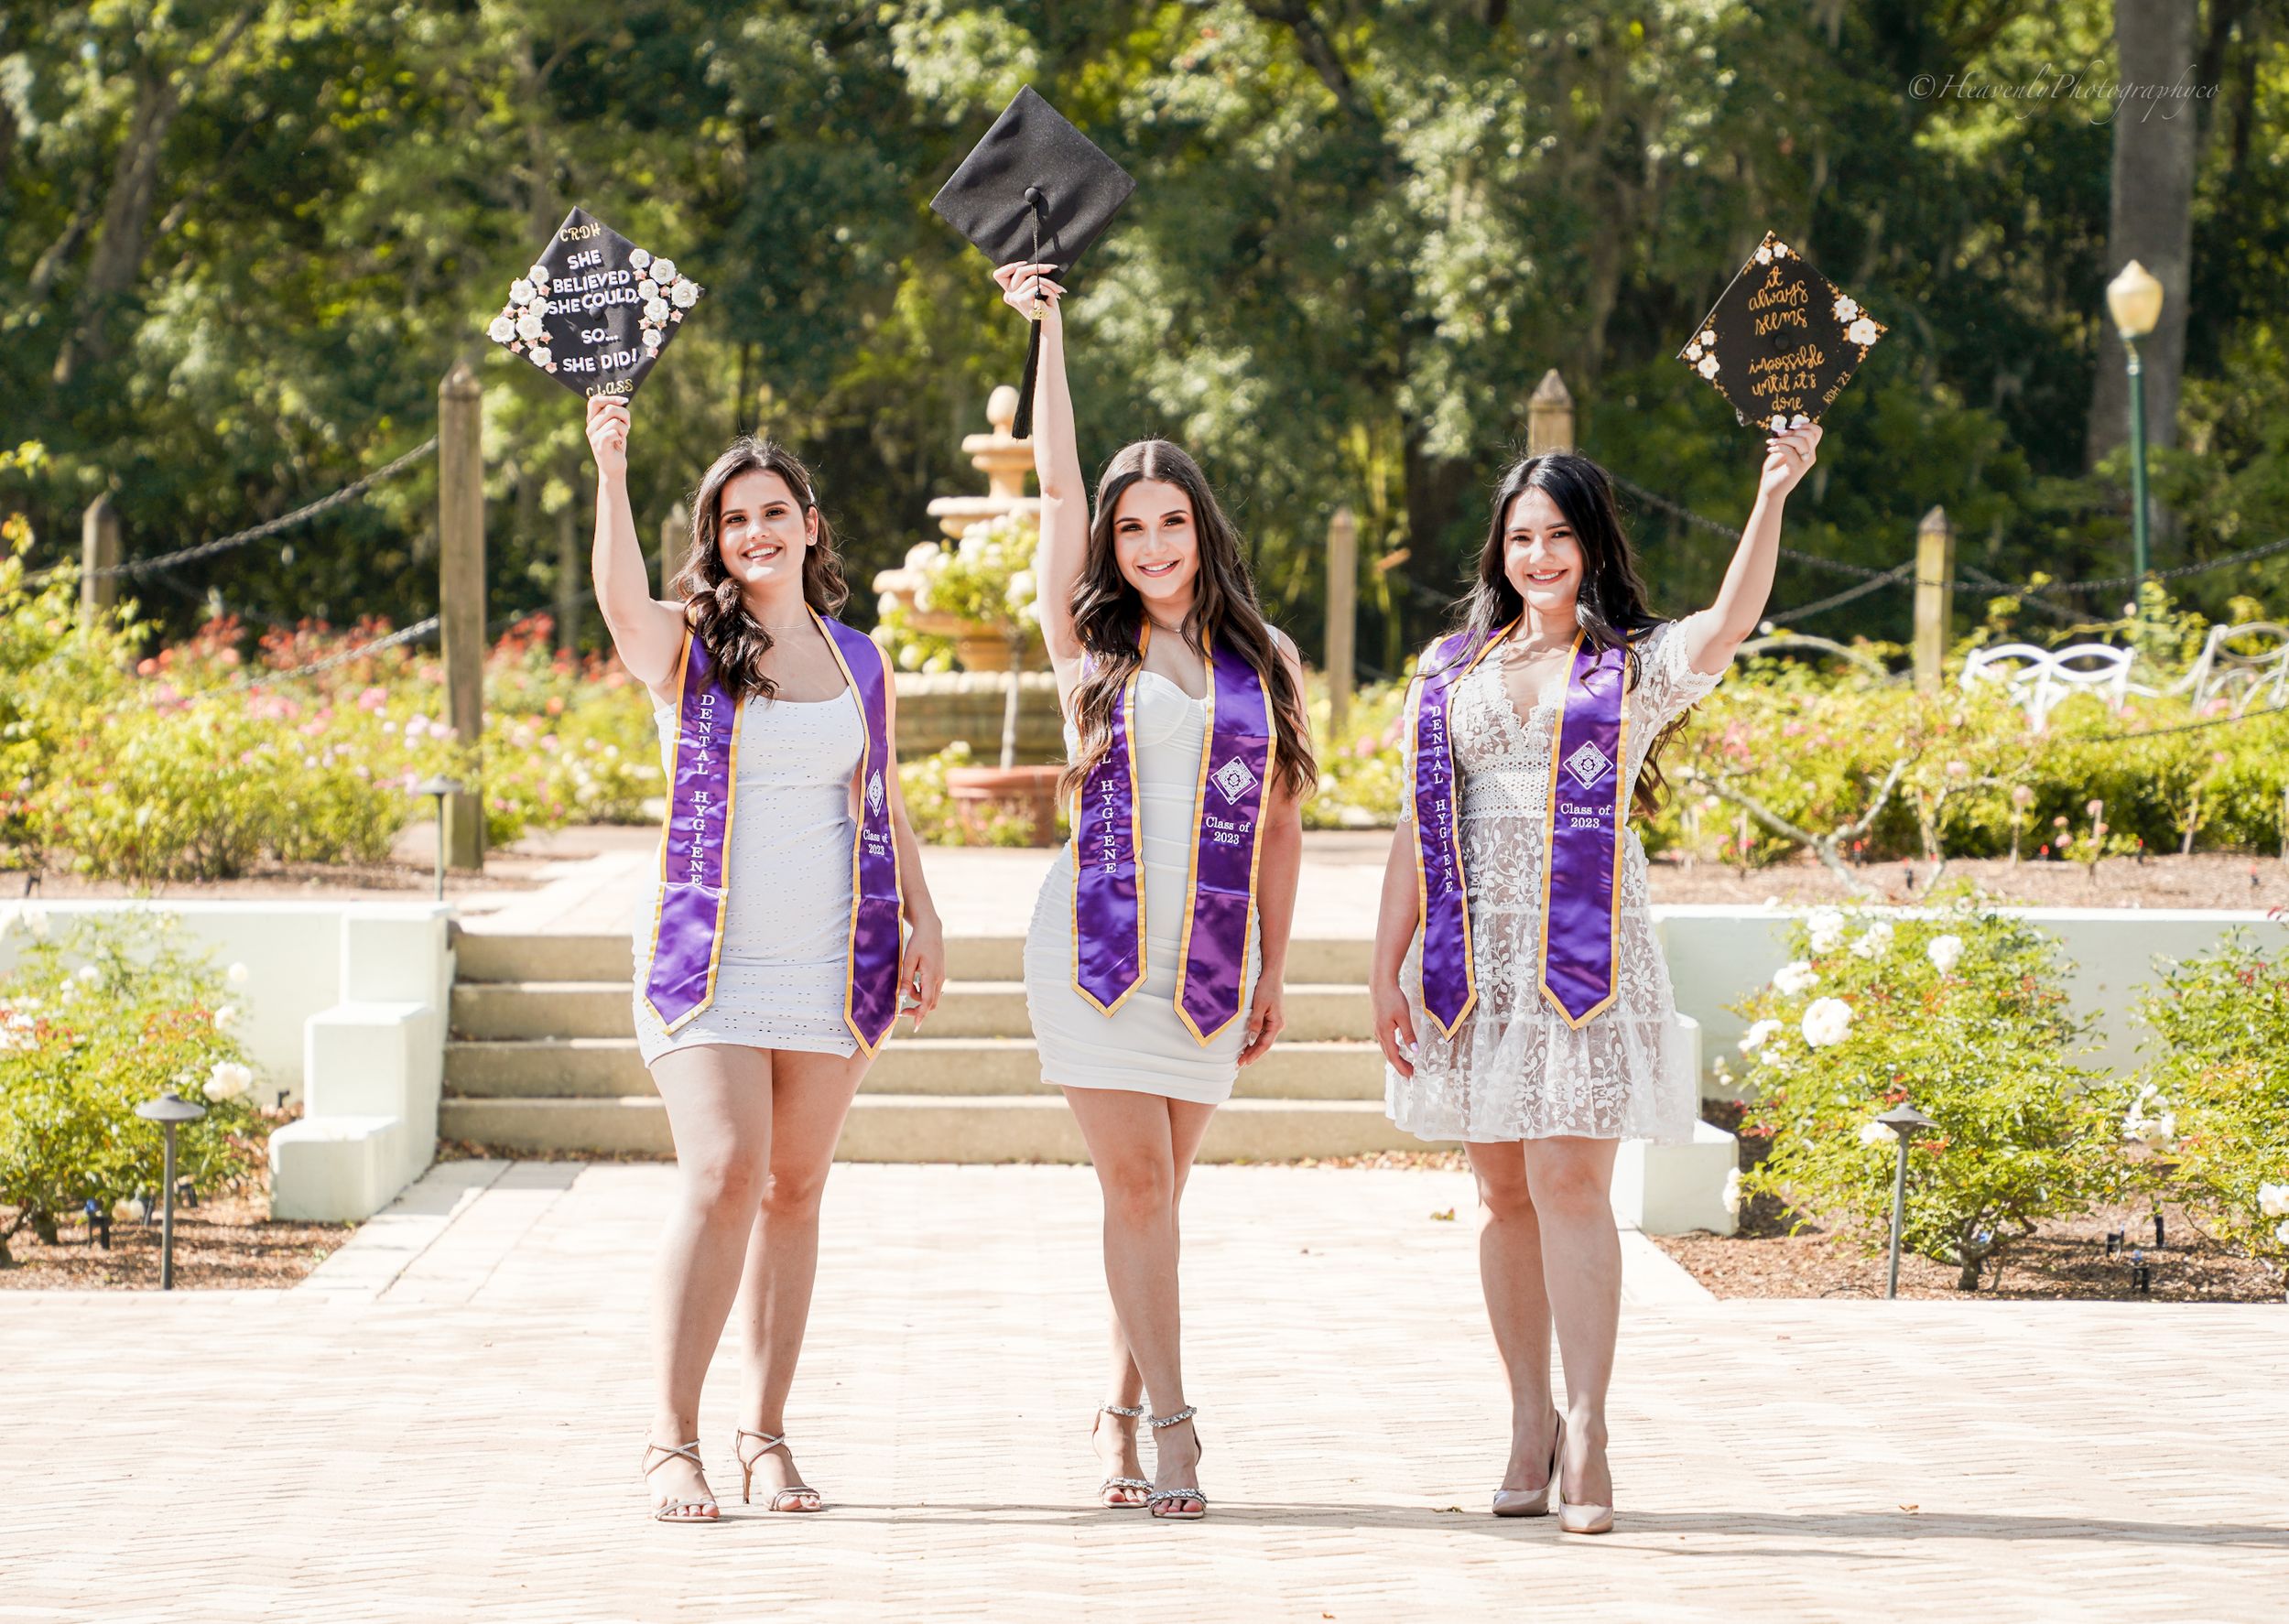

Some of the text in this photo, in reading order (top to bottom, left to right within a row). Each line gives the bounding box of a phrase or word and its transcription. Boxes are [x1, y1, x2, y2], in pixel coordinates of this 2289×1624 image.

[559, 222, 601, 242] CRDH
[567, 249, 602, 270] SHE
[552, 270, 630, 294] BELIEVED
[1763, 265, 1785, 290] it
[548, 288, 640, 315] SHE COULD,
[1748, 279, 1809, 311] always
[1754, 308, 1807, 336] seems
[581, 327, 618, 344] SO...
[562, 348, 637, 373] SHE DID!
[1749, 344, 1825, 374] impossible
[1752, 370, 1817, 396] until it's
[1771, 395, 1804, 412] done
[1822, 385, 1841, 406] RDH
[690, 694, 716, 886] DENTAL HYGIENE
[1430, 705, 1453, 893] DENTAL HYGIENE
[1560, 804, 1612, 817] Class of
[1101, 779, 1117, 874] HYGIENE
[1205, 817, 1251, 833] Class of
[1570, 817, 1600, 829] 2023
[862, 828, 880, 842] Class
[1213, 831, 1240, 845] 2023
[868, 843, 885, 856] 2023
